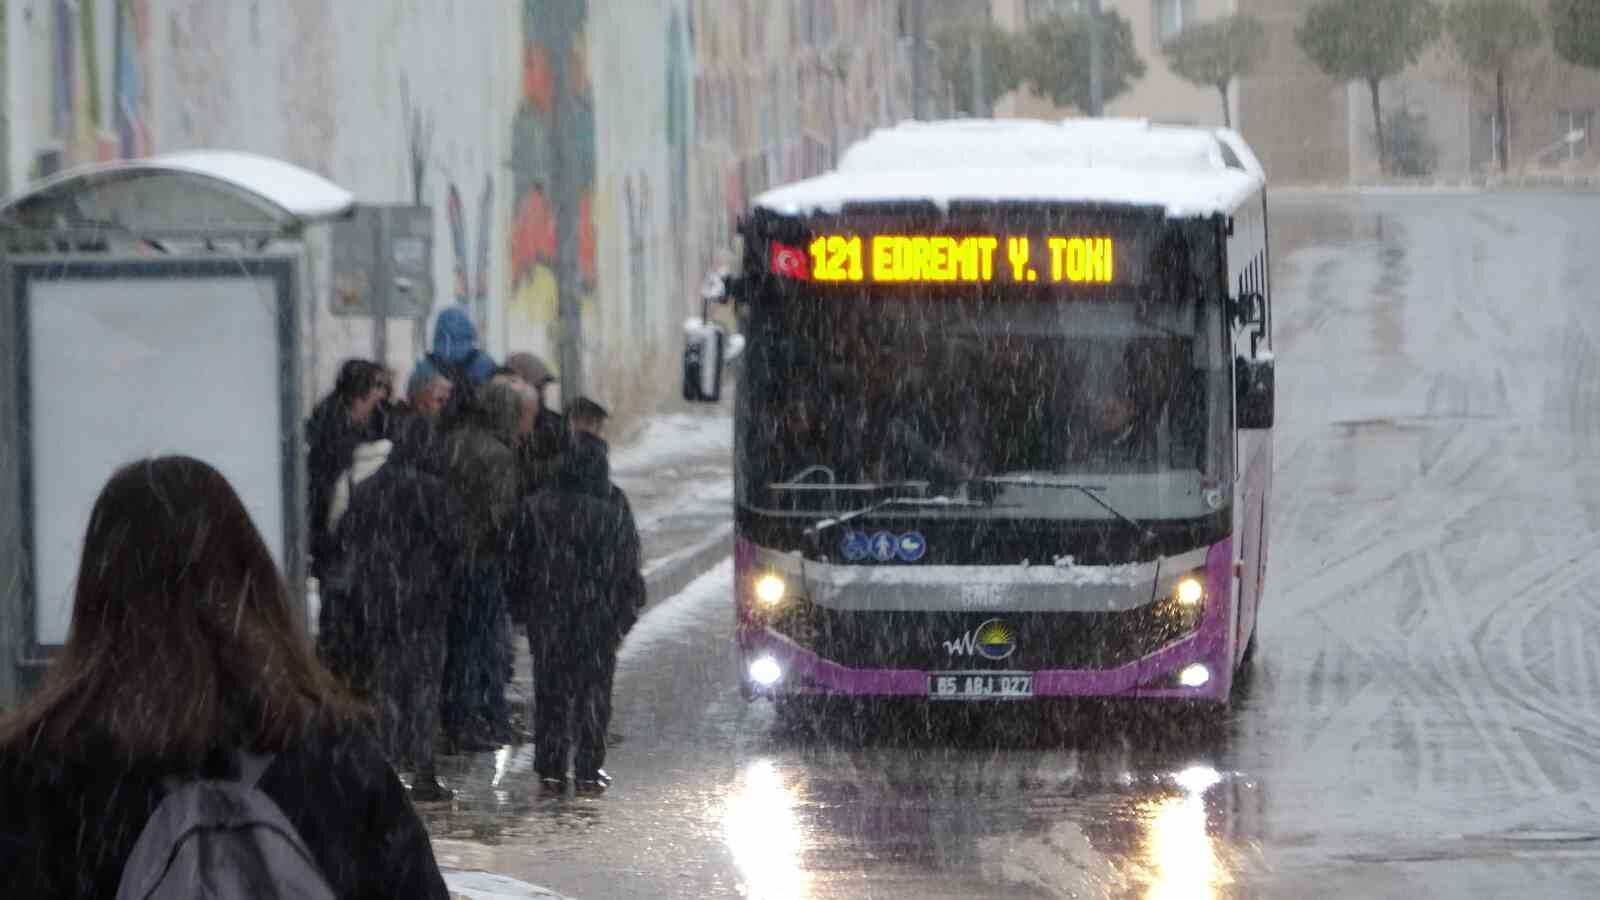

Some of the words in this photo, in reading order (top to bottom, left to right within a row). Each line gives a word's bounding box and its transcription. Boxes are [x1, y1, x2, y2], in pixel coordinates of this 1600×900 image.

[810, 236, 863, 280] 121
[873, 236, 997, 281] EDREMIT
[1008, 236, 1037, 281] Y.
[1048, 236, 1112, 281] TOKI
